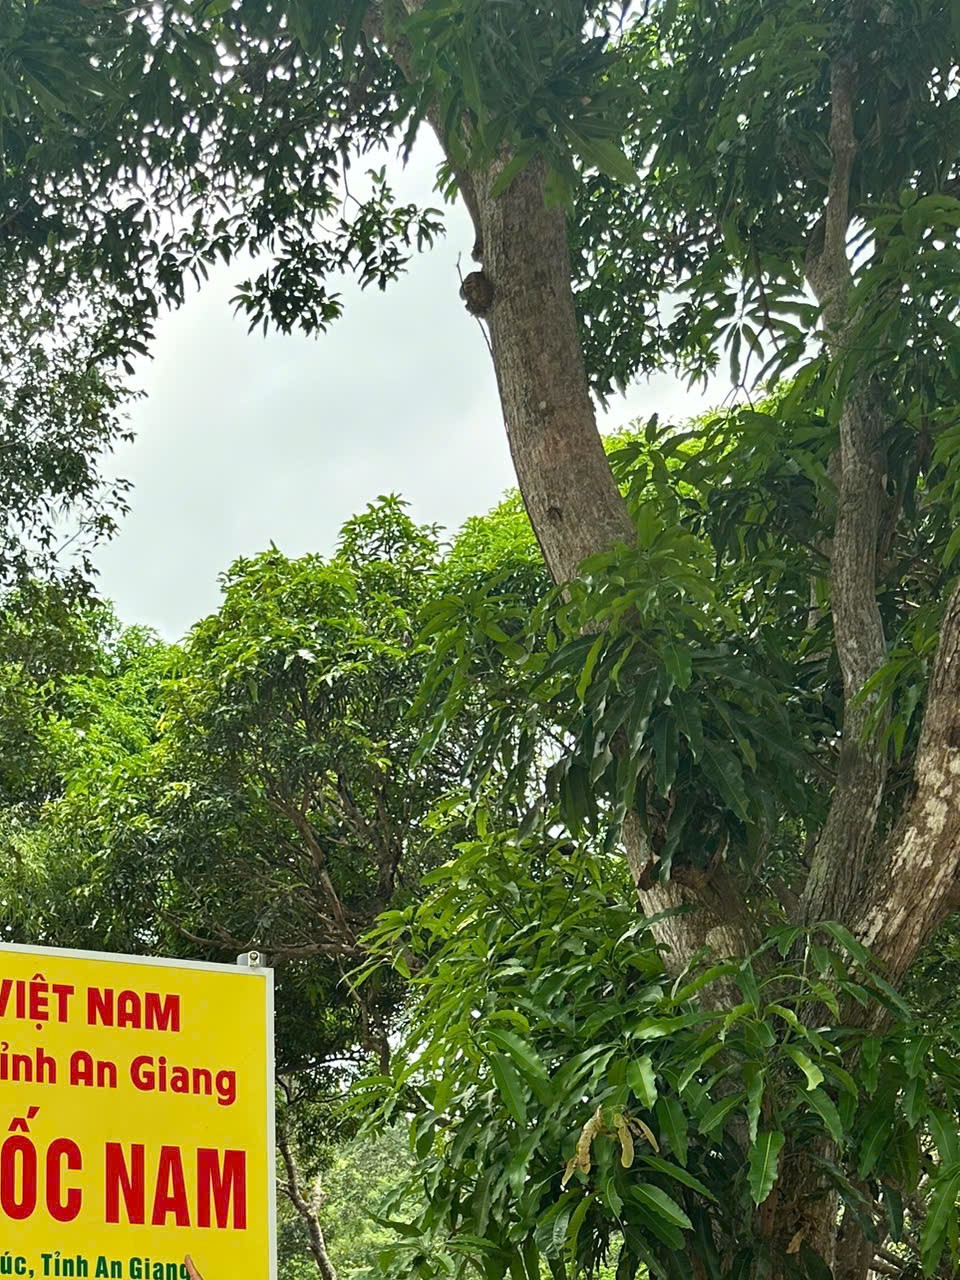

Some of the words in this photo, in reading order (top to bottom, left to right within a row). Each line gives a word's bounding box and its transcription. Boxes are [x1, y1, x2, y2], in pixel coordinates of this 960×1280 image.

[87, 986, 181, 1033] NAM
[69, 1050, 118, 1089] An
[129, 1055, 237, 1106] Giang
[104, 1141, 247, 1230] NAM
[41, 1251, 89, 1277] Tỉnh
[95, 1256, 123, 1279] An
